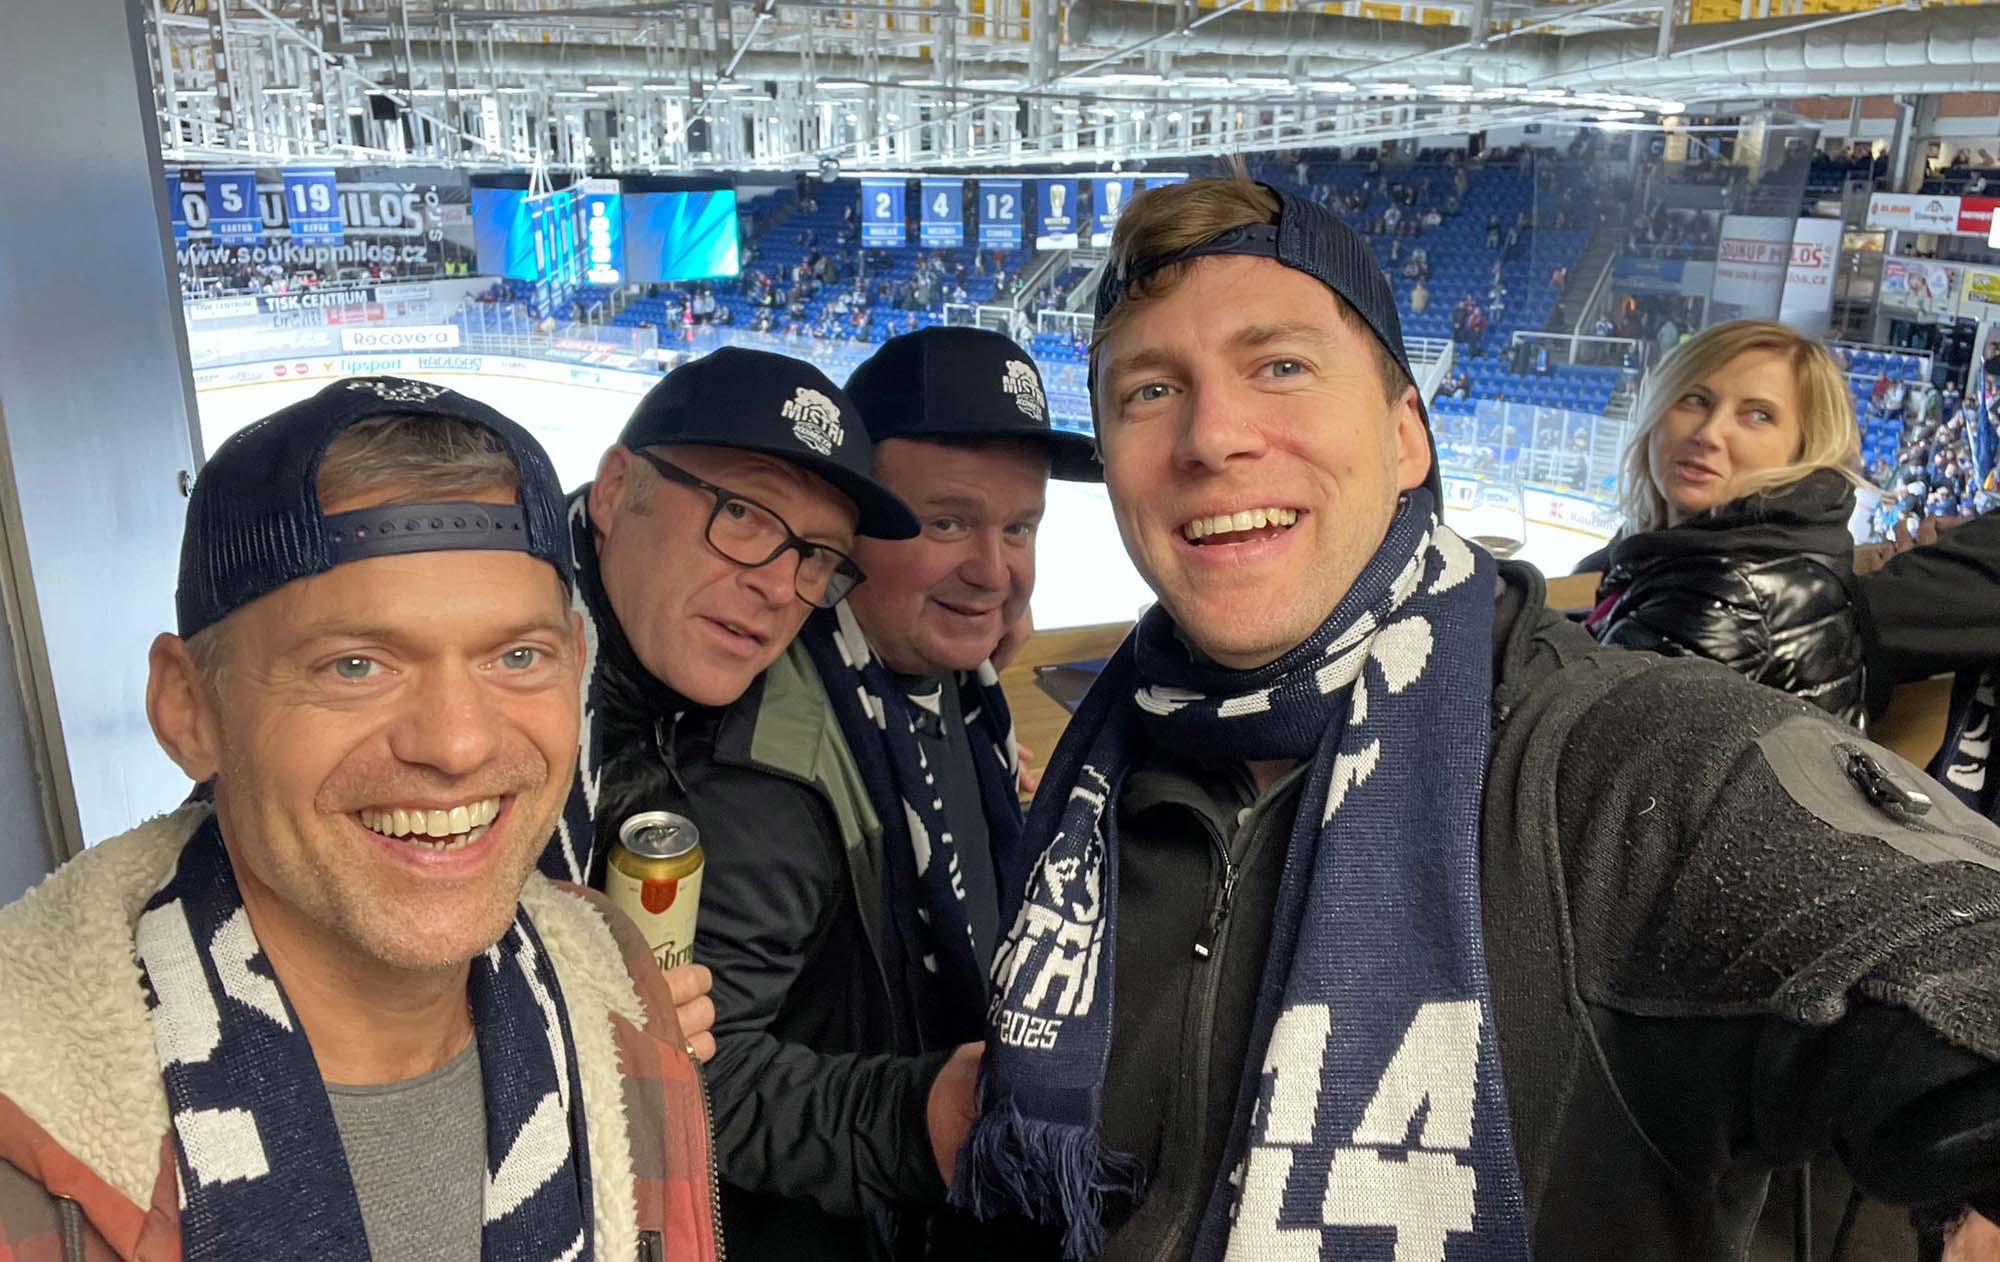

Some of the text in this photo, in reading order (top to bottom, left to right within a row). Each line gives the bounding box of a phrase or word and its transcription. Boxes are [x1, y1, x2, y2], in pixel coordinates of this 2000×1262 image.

[220, 183, 243, 212] 5
[291, 183, 331, 213] 19
[874, 192, 892, 219] 2
[932, 192, 949, 219] 4
[986, 193, 1014, 220] 12
[265, 296, 301, 310] TISK
[302, 290, 368, 307] CENTRUM
